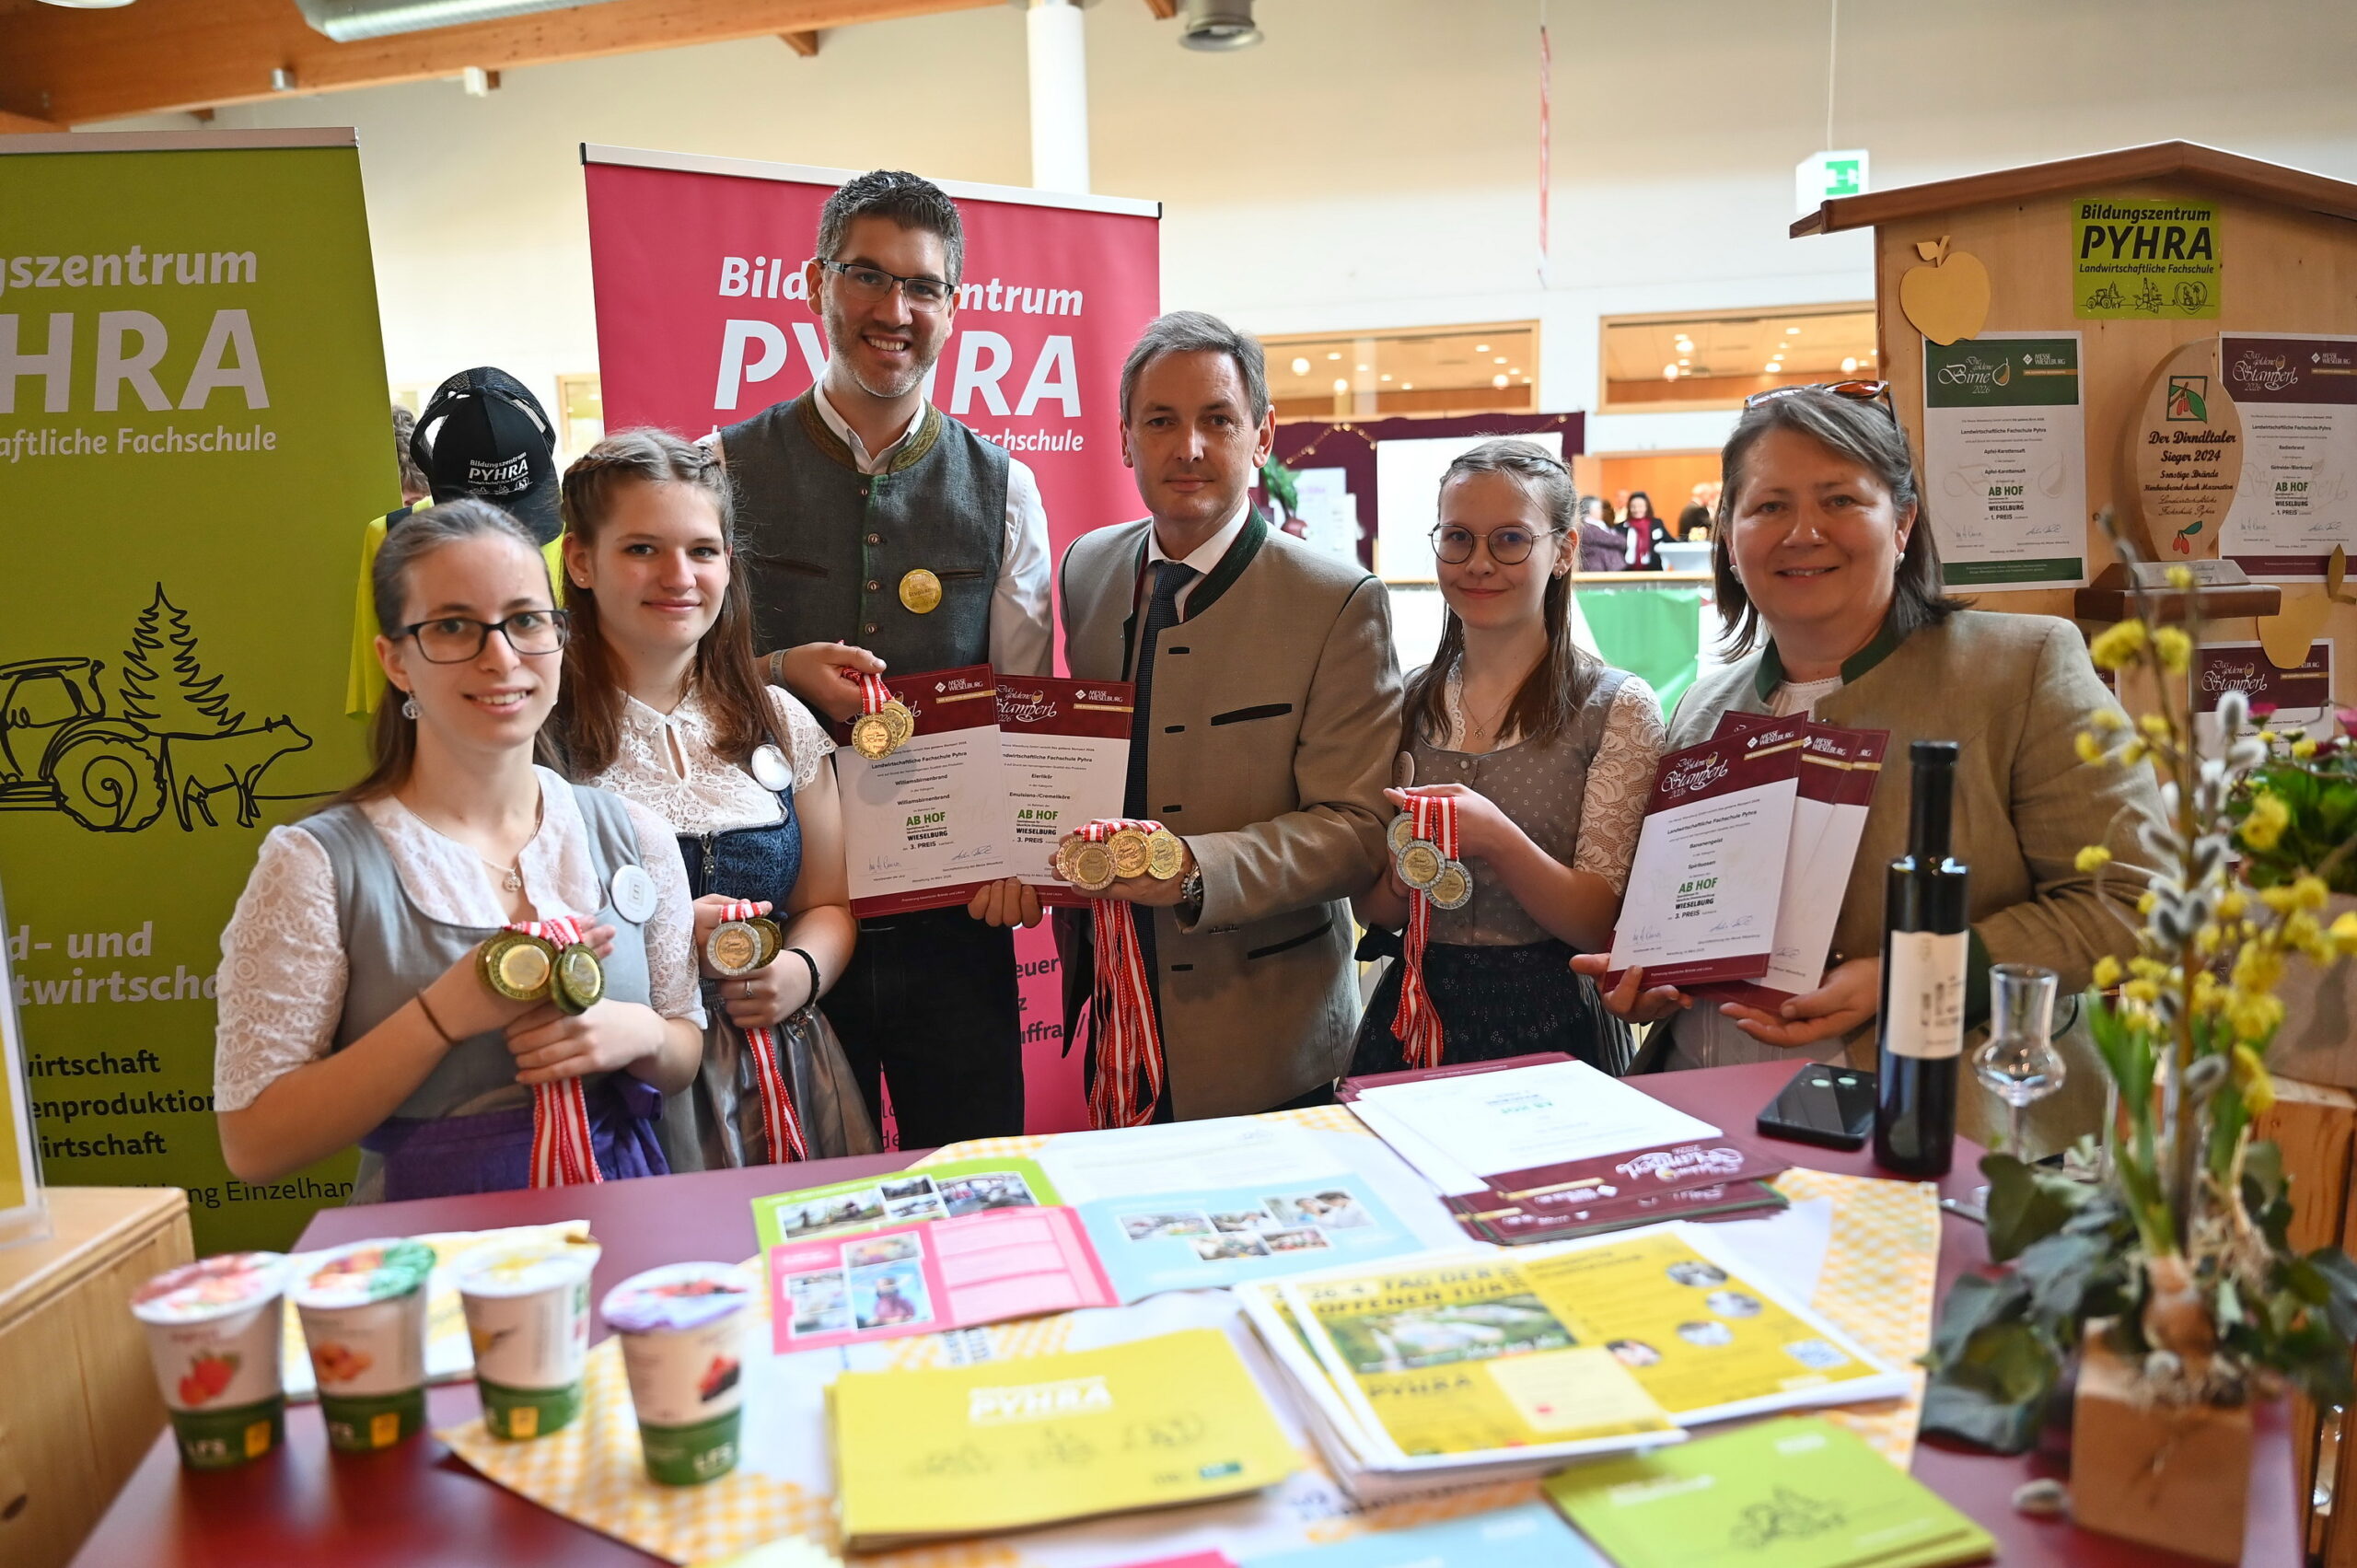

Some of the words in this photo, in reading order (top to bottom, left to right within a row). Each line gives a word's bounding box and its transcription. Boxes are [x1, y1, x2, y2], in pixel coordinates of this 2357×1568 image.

[2081, 203, 2211, 224] Bildungszentrum
[2080, 225, 2212, 261] PYHRA
[0, 245, 257, 297] szentrum
[2079, 262, 2165, 275] Landwirtschaftliche
[2167, 263, 2214, 273] Fachschule
[1938, 364, 1991, 384] Birne
[2233, 360, 2298, 388] Stamperl
[1972, 385, 1991, 394] 2026
[117, 424, 277, 454] Fachschule
[2149, 431, 2170, 445] Der
[2173, 430, 2236, 445] Dirndltaler
[2161, 450, 2191, 465] Sieger
[2193, 449, 2222, 462] 2024
[469, 459, 528, 481] PYHRA
[1988, 487, 2002, 496] AB
[2004, 486, 2024, 496] HOF
[2275, 482, 2288, 492] AB
[2291, 482, 2309, 492] HOF
[2201, 670, 2268, 693] Stamperl
[871, 758, 921, 770] Landwirtschaftliche
[922, 753, 952, 762] Fachschule
[952, 751, 968, 760] Pyhra
[895, 774, 948, 786] Williamsbirnenbrand
[1661, 759, 1728, 792] Stamperl
[897, 795, 950, 806] Williamsbirnenbrand
[906, 816, 922, 827] AB
[923, 812, 946, 824] HOF
[1017, 809, 1033, 819] AB
[1036, 810, 1059, 820] HOF
[907, 830, 948, 842] WIESELBURG
[1016, 827, 1057, 835] WIESELBURG
[917, 842, 936, 850] PREIS
[1678, 882, 1693, 893] AB
[1695, 877, 1718, 890] HOF
[1675, 899, 1714, 910] WIESELBURG
[1681, 910, 1701, 918] PREIS
[67, 921, 153, 959] und
[970, 1384, 1111, 1422] PYHRA
